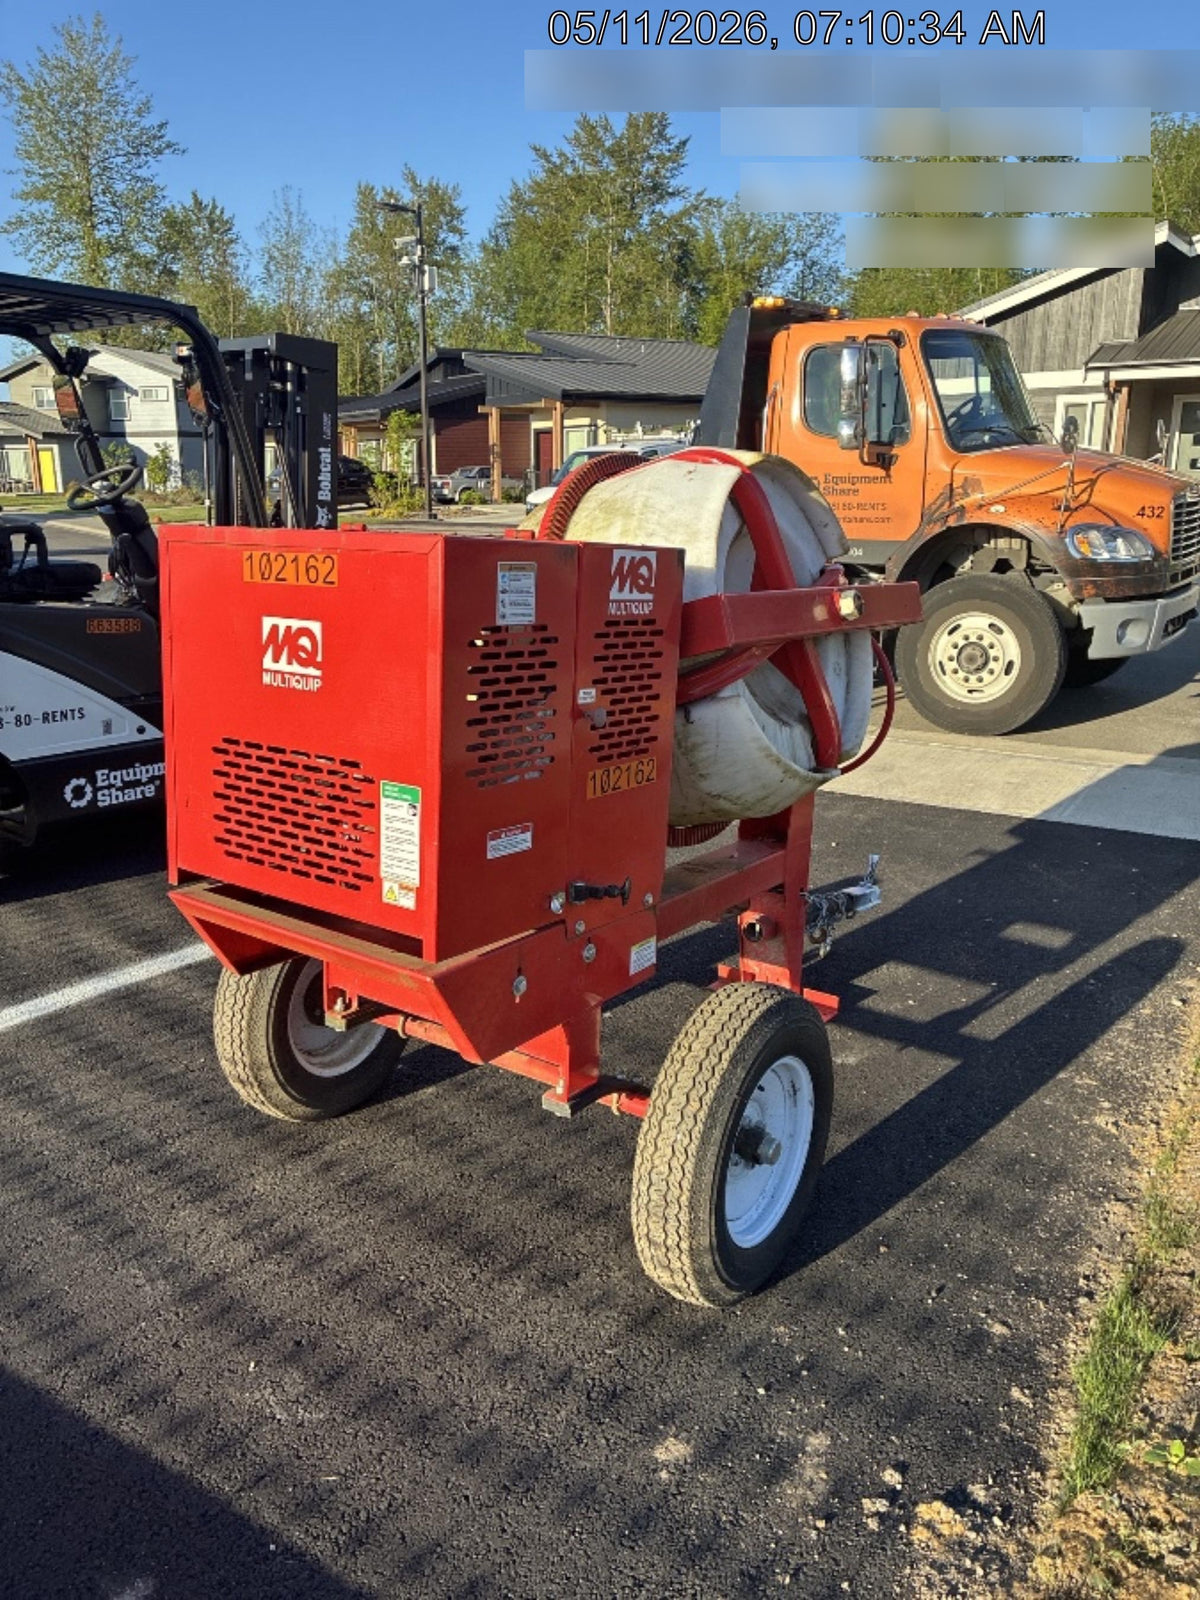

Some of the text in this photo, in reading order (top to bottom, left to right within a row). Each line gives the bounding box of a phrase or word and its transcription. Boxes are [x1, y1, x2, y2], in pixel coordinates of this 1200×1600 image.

[317, 446, 332, 501] Bobcat
[822, 473, 893, 485] Equipment
[822, 486, 860, 497] Share
[245, 552, 336, 585] 102162
[262, 620, 322, 673] MQ
[262, 671, 322, 692] MULTIQUIP
[590, 758, 655, 796] 102162
[97, 783, 155, 807] Share
